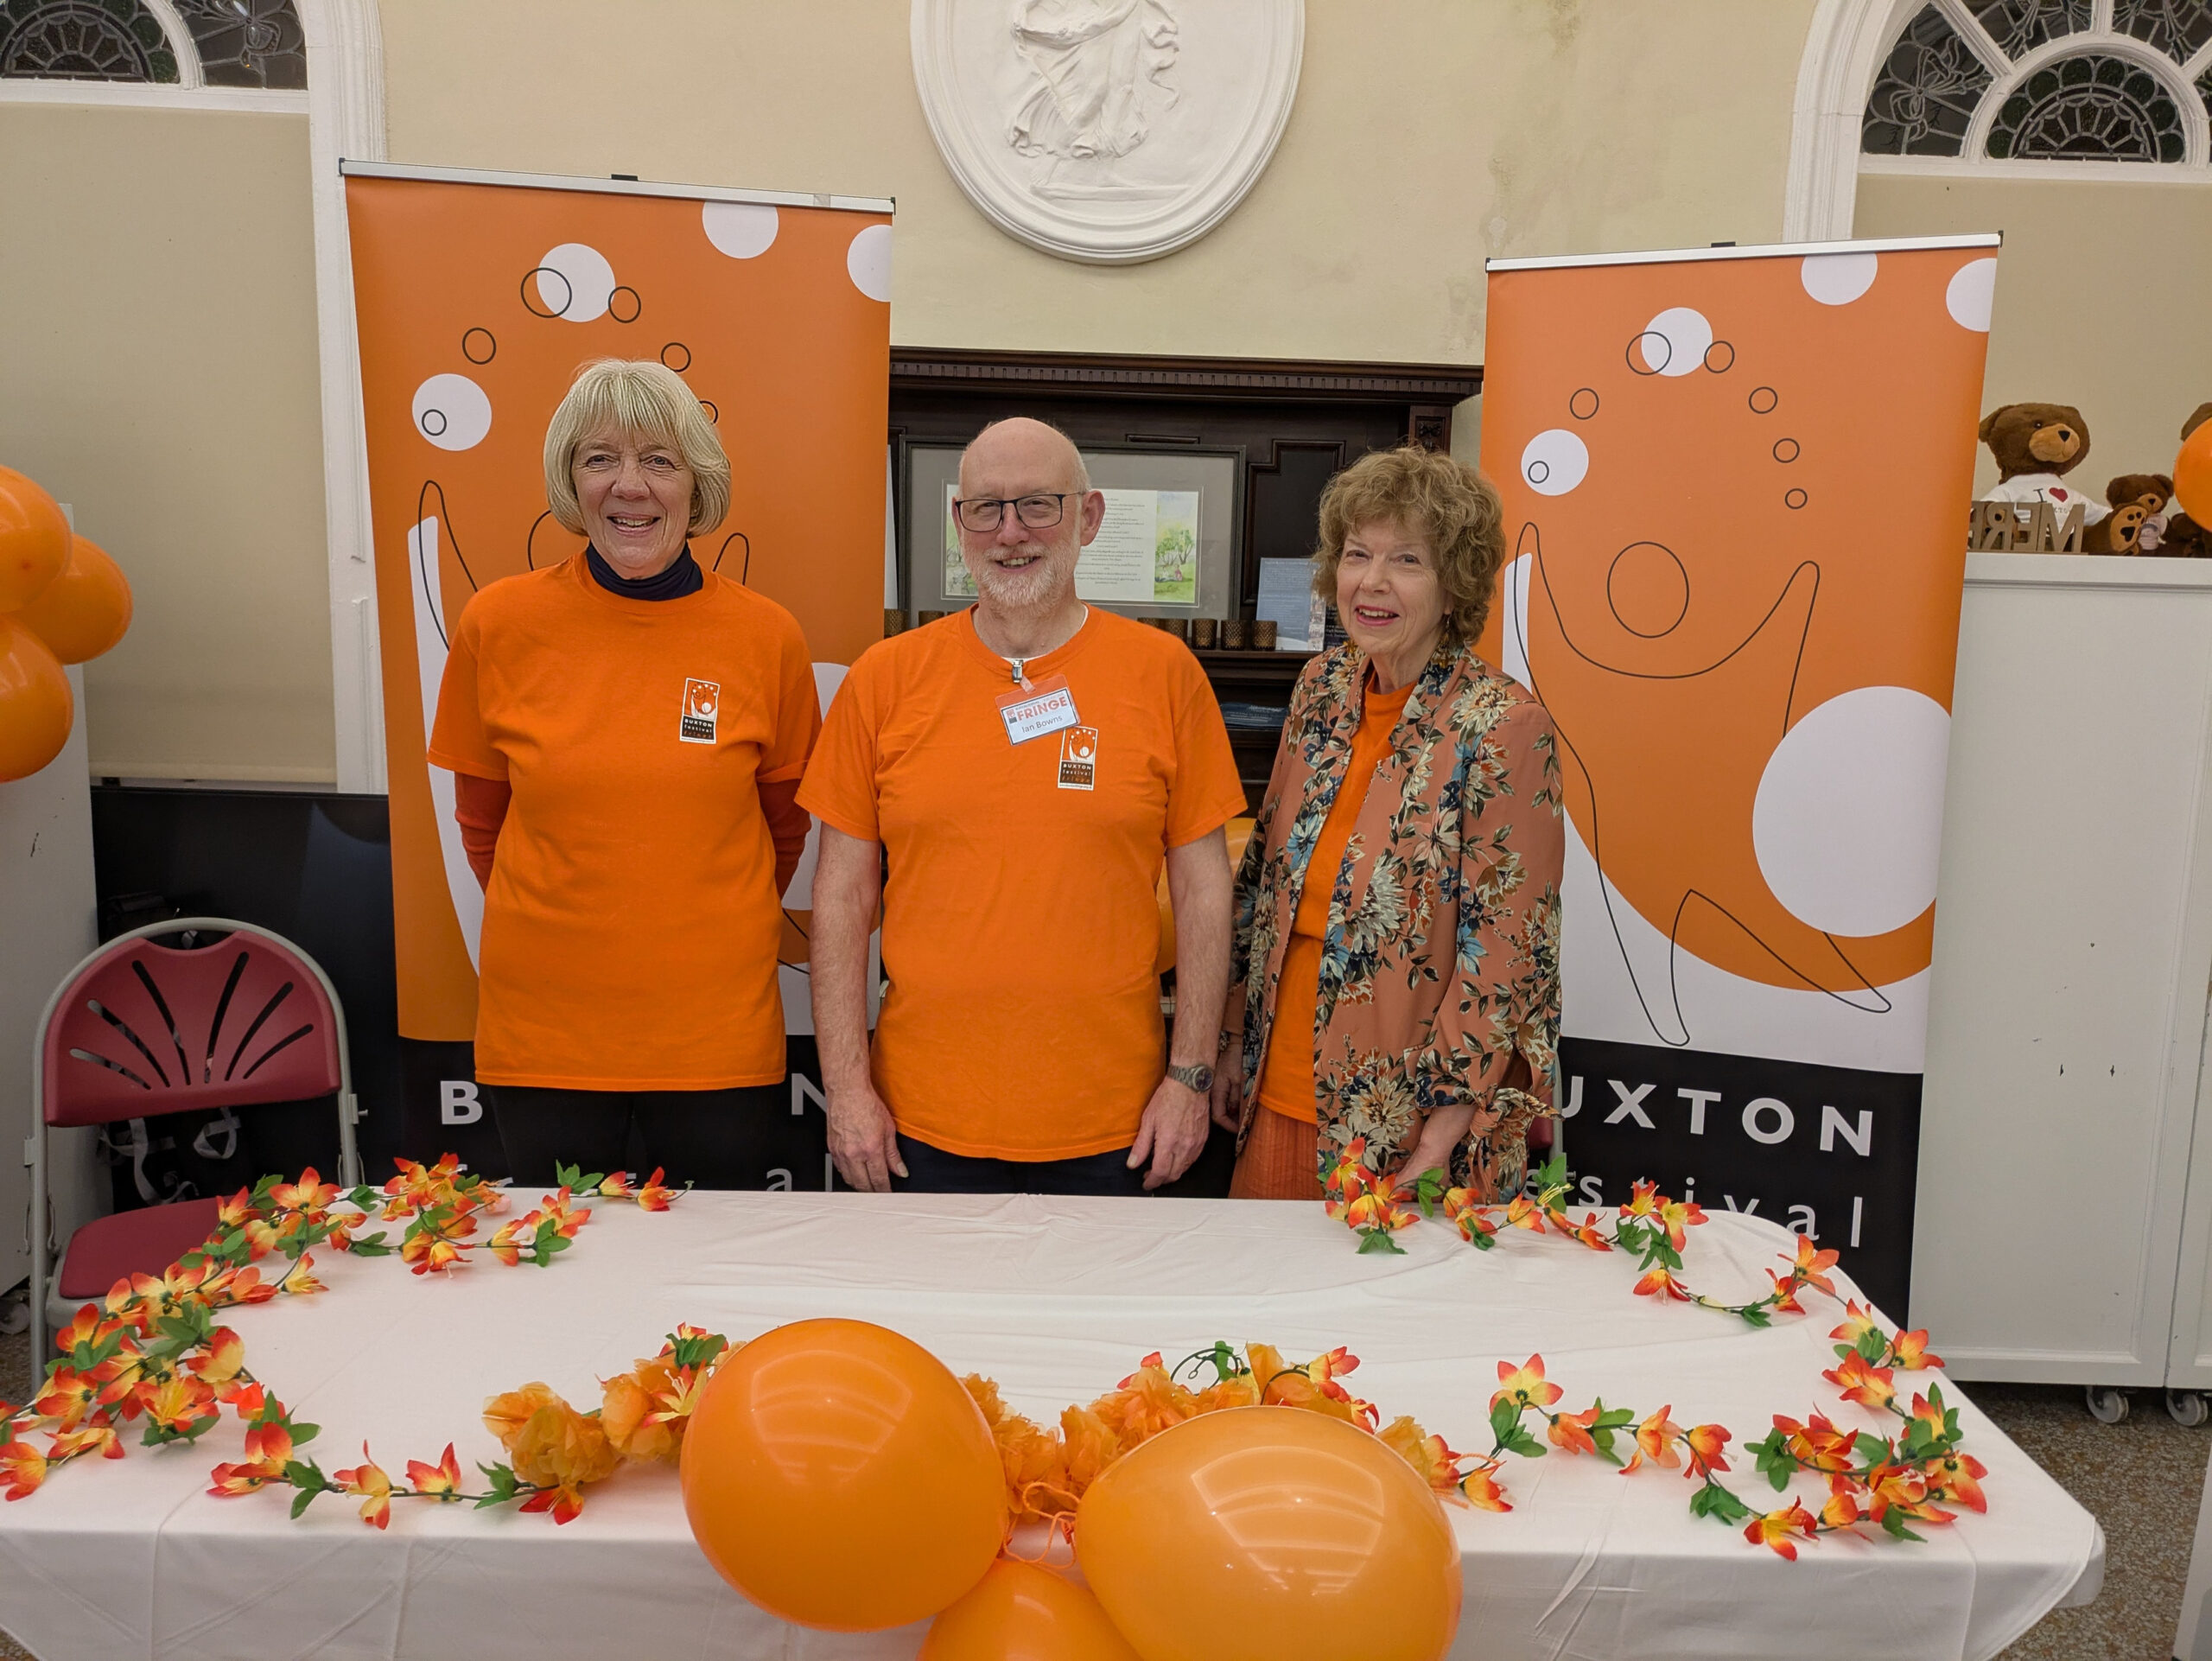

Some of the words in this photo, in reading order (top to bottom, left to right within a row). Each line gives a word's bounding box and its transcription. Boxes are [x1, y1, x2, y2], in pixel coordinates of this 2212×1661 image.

[1016, 696, 1067, 722] FRINGE
[684, 718, 713, 728] BUXTON
[1021, 724, 1034, 733] Ian
[1035, 715, 1063, 729] Bowns
